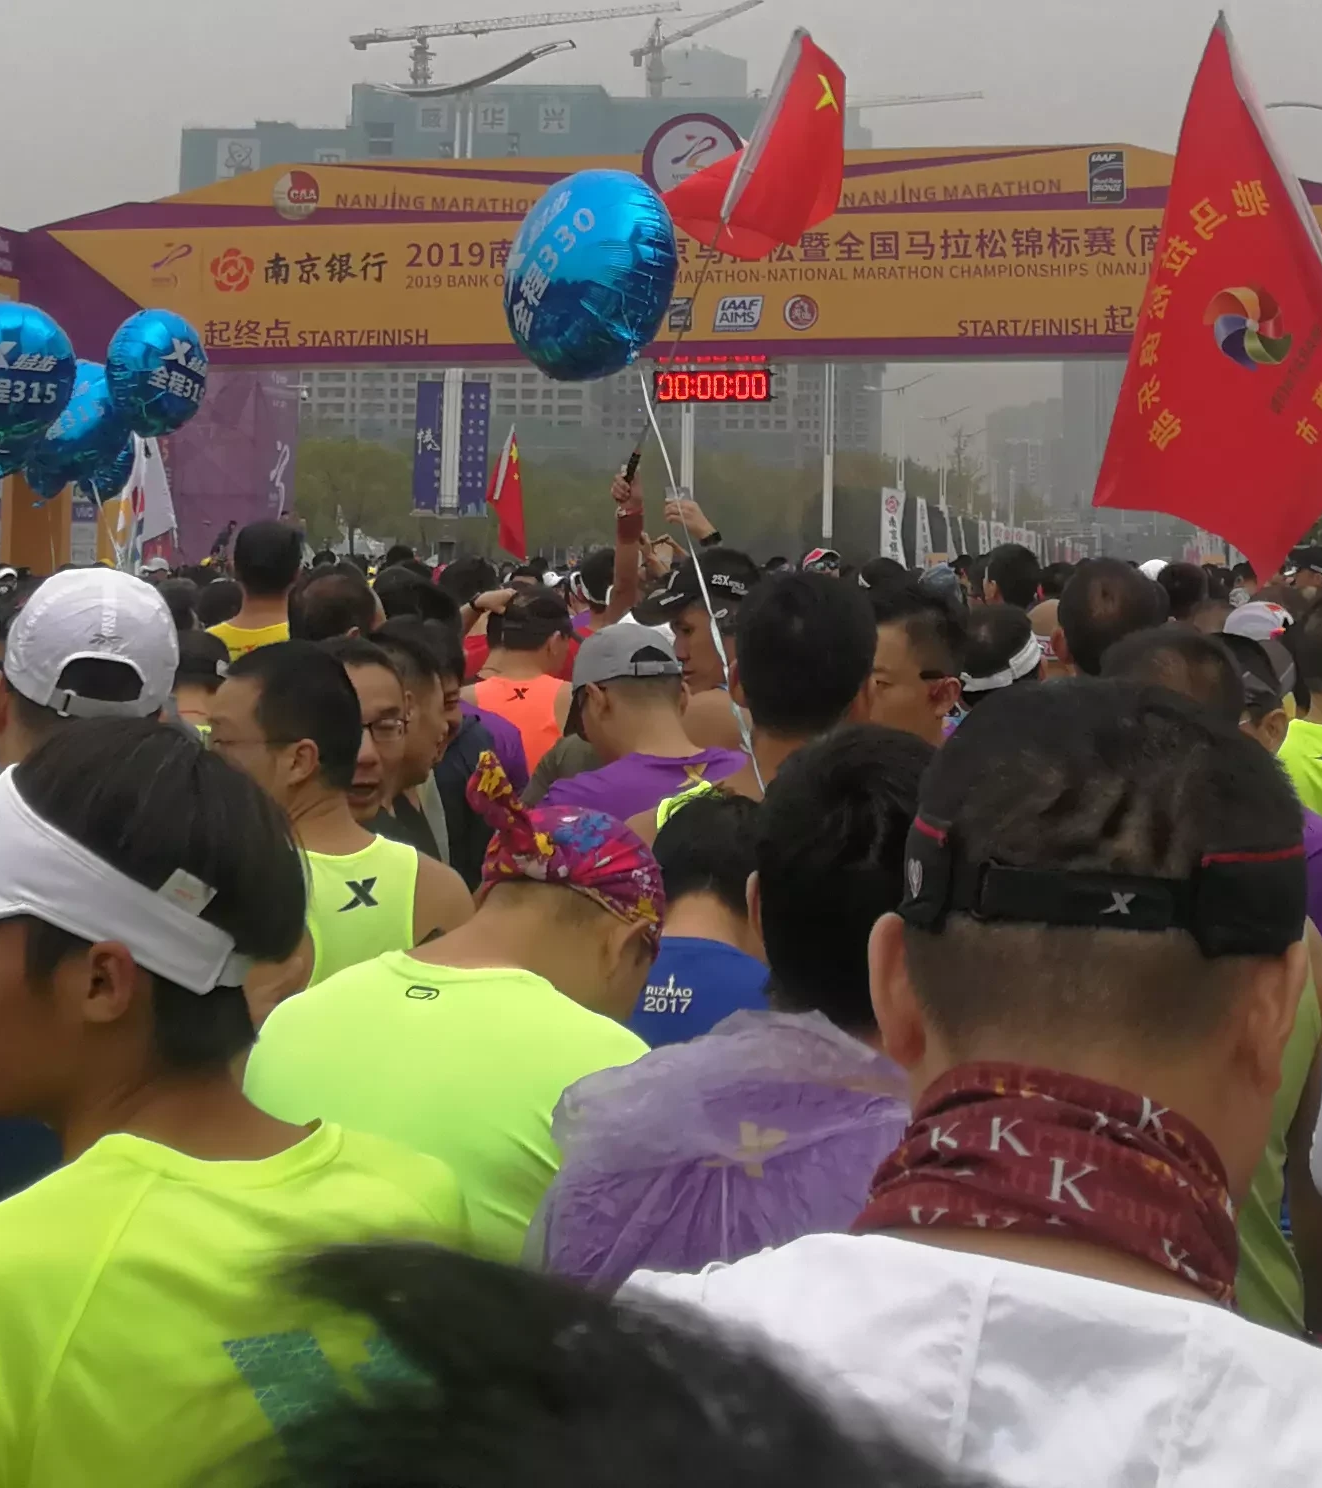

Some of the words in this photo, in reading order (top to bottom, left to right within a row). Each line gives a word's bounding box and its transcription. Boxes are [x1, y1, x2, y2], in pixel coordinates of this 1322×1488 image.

[335, 186, 425, 210] NANJING
[431, 195, 538, 213] MARATHO
[843, 180, 937, 208] NANJING
[943, 178, 1062, 202] MARATHON
[263, 251, 389, 286] 南京银行
[405, 275, 443, 290] 2019
[447, 273, 489, 289] BANK
[853, 265, 944, 280] MARATHON
[949, 263, 1089, 279] CHAMPIONSHIPS
[718, 311, 756, 323] AIMS
[720, 299, 760, 311] IAAF
[204, 318, 293, 348] 起终点
[297, 328, 429, 347] START/FINISH
[957, 317, 1098, 338] START/FINISH
[645, 973, 693, 998] RIZHAO
[643, 996, 692, 1014] 2017
[989, 1116, 1032, 1157] K
[1044, 1156, 1099, 1212] K
